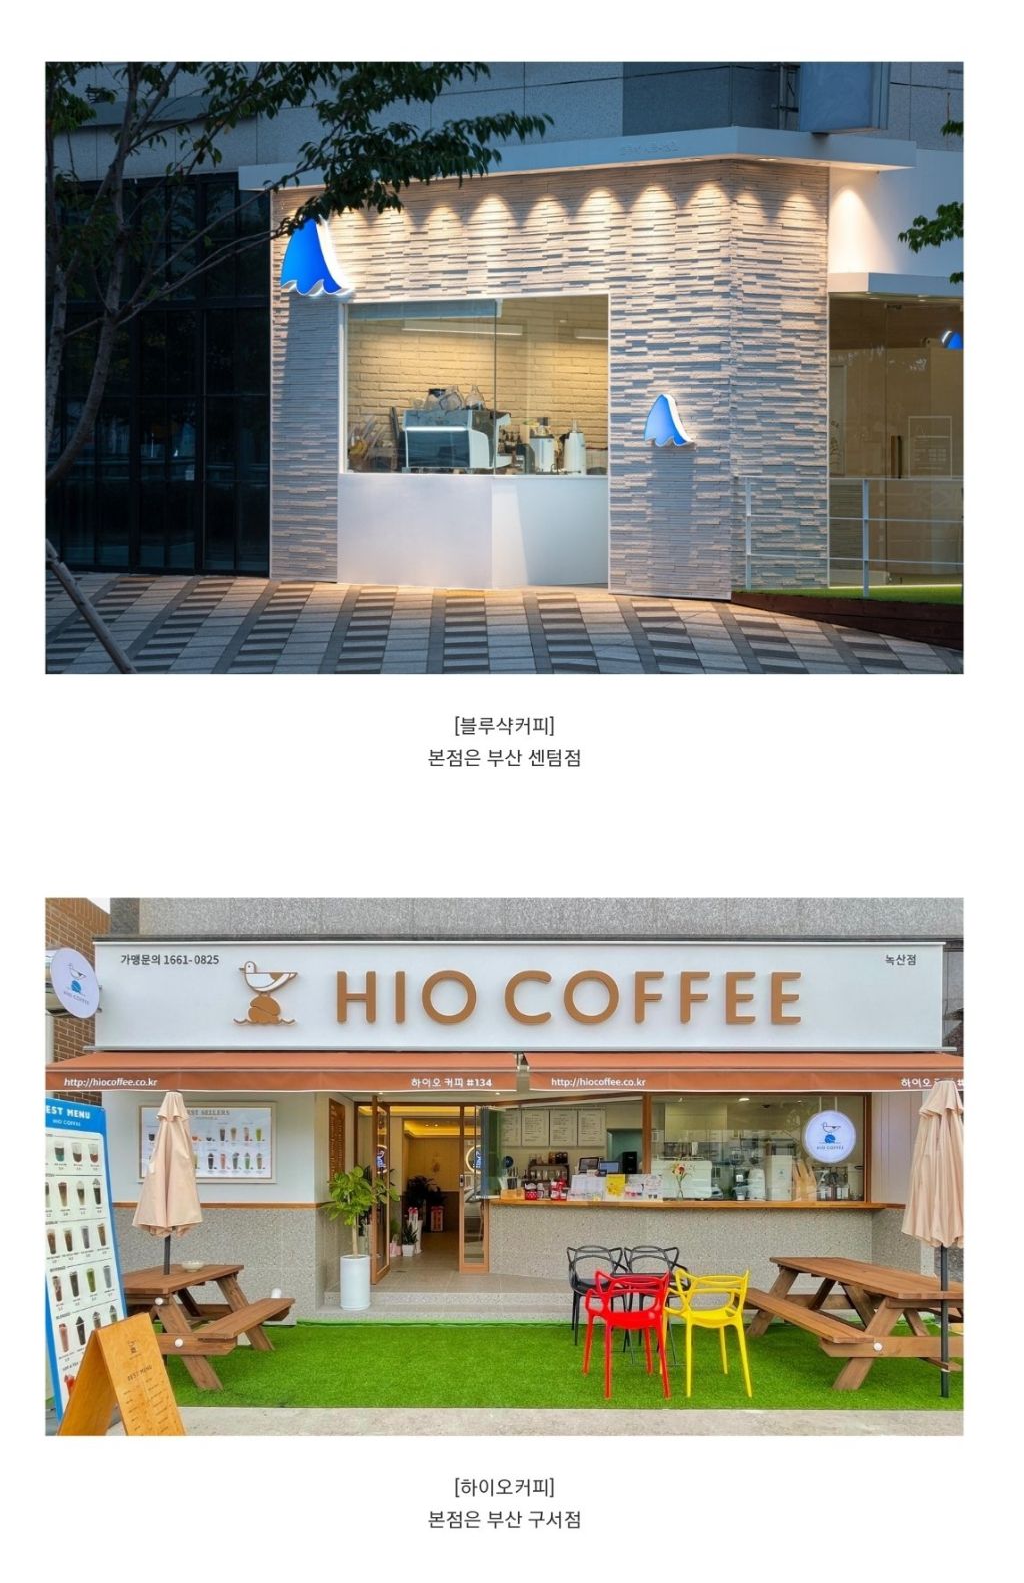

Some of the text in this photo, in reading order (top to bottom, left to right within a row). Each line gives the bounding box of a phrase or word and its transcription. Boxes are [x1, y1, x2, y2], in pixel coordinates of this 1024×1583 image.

[120, 953, 161, 966] 가맹문의
[884, 953, 918, 967] 녹산점
[336, 969, 802, 1026] HIO COFFEE
[64, 1077, 158, 1089] http://hiocoffee.co.kr
[411, 1077, 493, 1088] 하이오 커피 #134
[551, 1077, 647, 1089] http://hiocoffee.co.kr
[901, 1077, 932, 1088] 하이오
[66, 1107, 92, 1120] MENU
